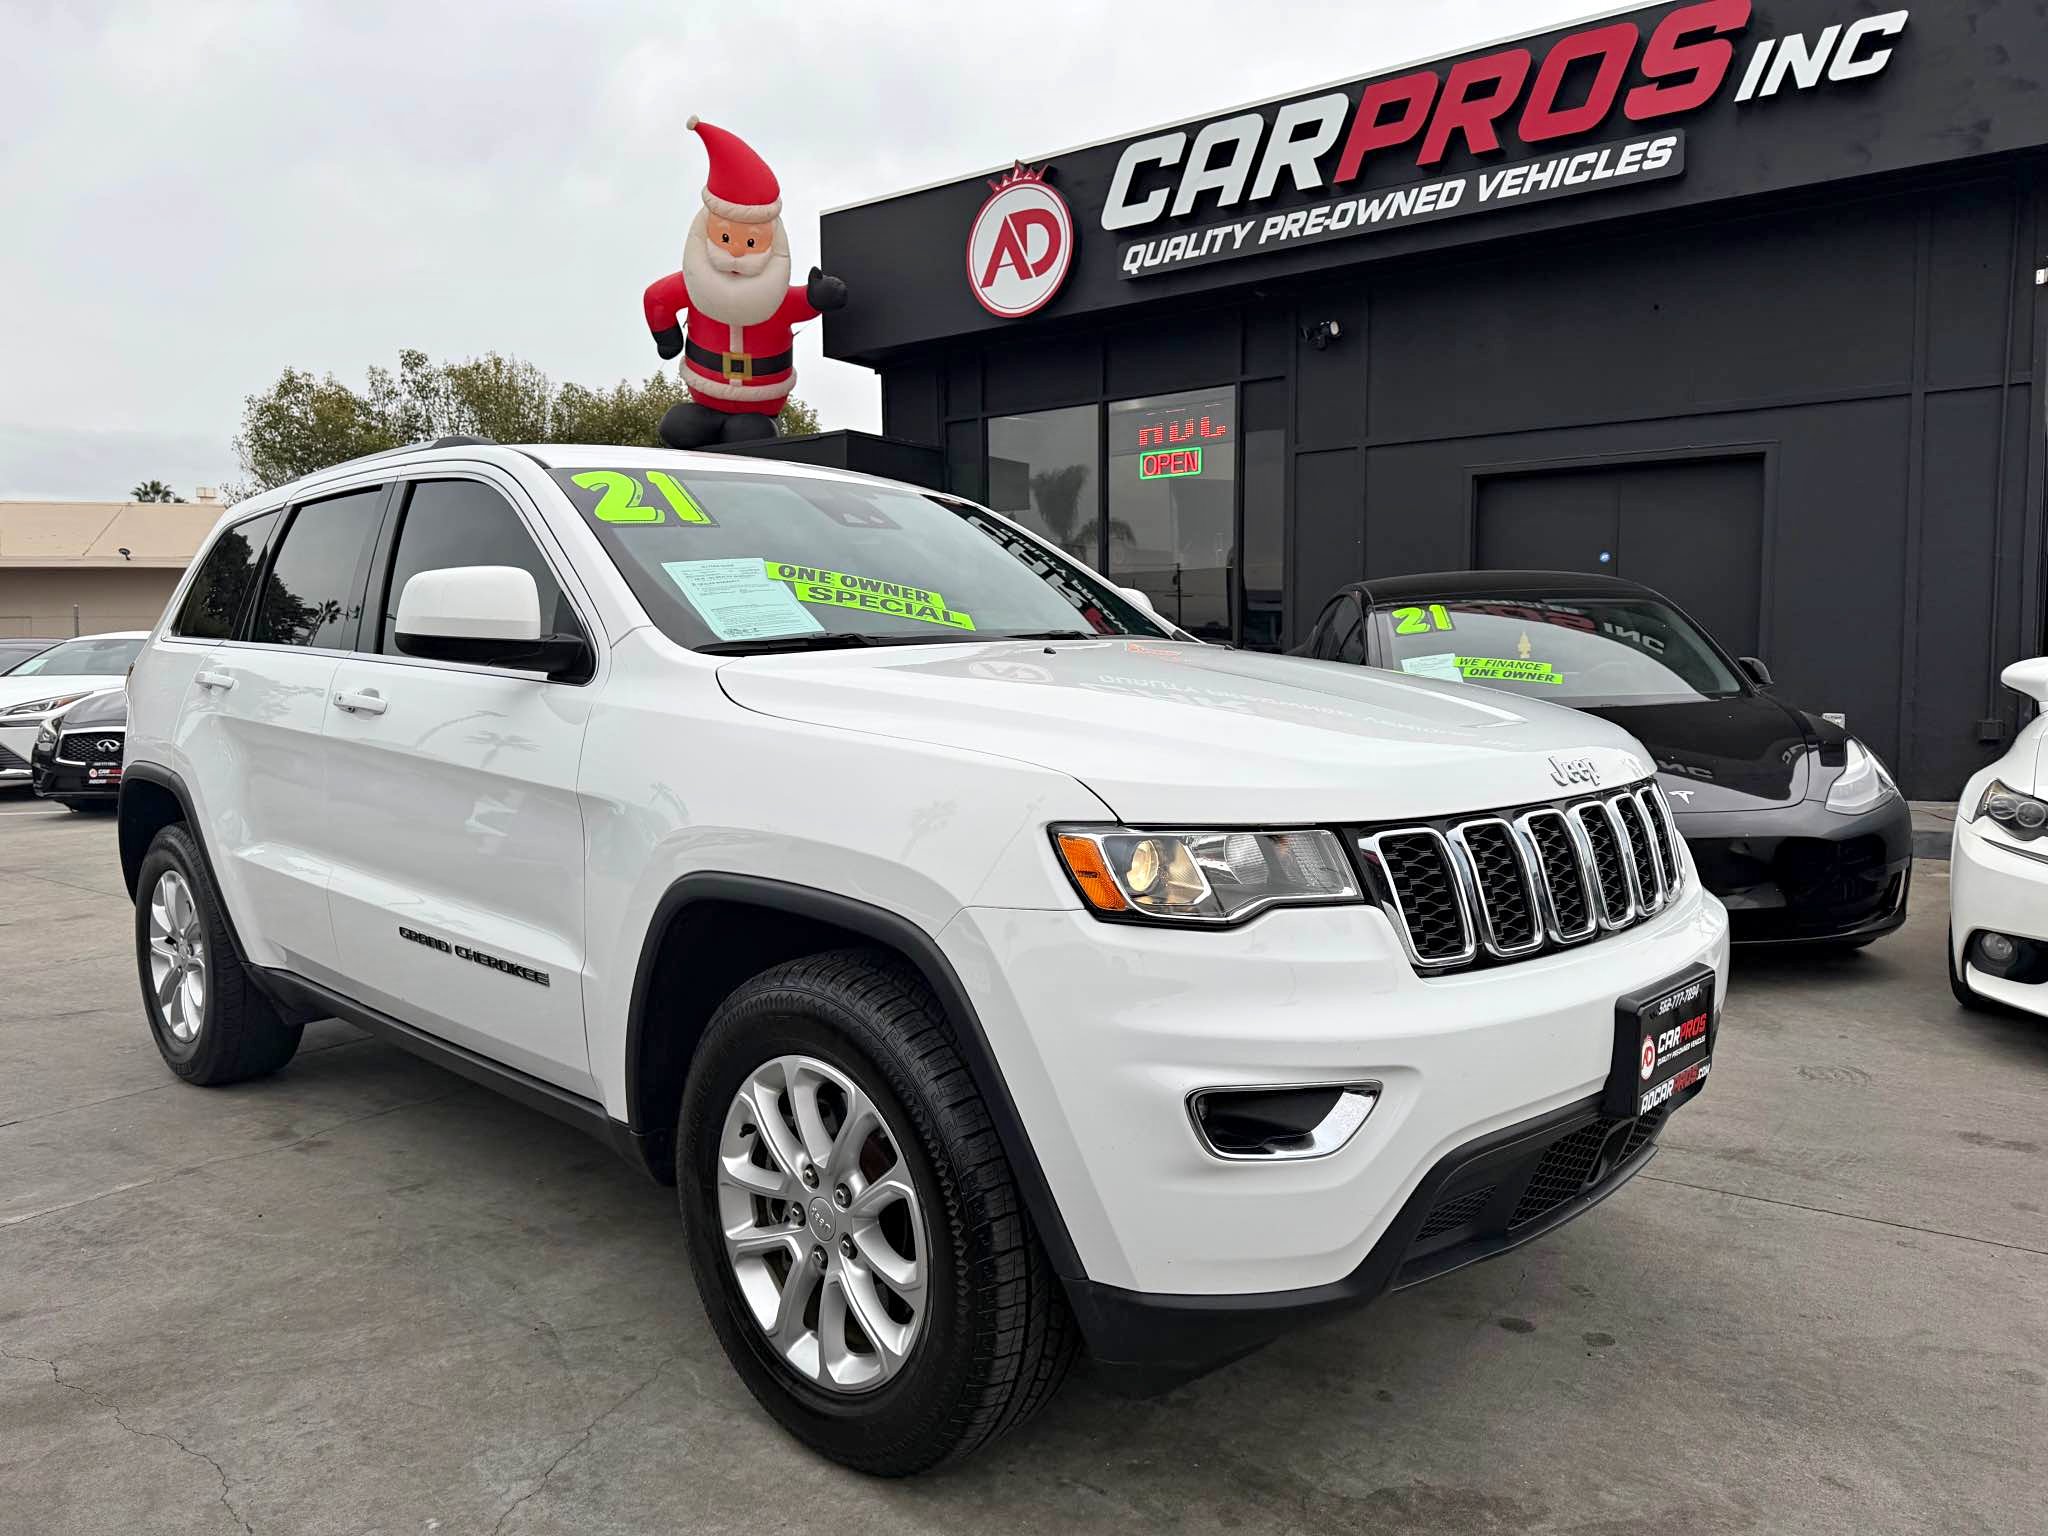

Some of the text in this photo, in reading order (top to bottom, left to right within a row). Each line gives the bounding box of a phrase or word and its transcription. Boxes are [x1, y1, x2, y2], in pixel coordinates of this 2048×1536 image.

[1101, 0, 1909, 230] CARPROS INC
[1122, 136, 1677, 274] QUALITY PRE-OWNED VEHICLES
[980, 208, 1062, 288] AD
[1143, 451, 1198, 476] OPEN
[570, 470, 712, 524] 21
[778, 565, 930, 603] ONE OWNER
[808, 586, 963, 626] SPECIAL
[1392, 604, 1453, 635] 21
[1459, 657, 1479, 667] WE
[1485, 658, 1543, 671] FINANCE
[1469, 668, 1555, 682] ONE OWNER
[1548, 755, 1601, 787] Jeep
[399, 926, 551, 987] GRAND CHEROKEE
[1658, 1012, 1708, 1053] CARPROS
